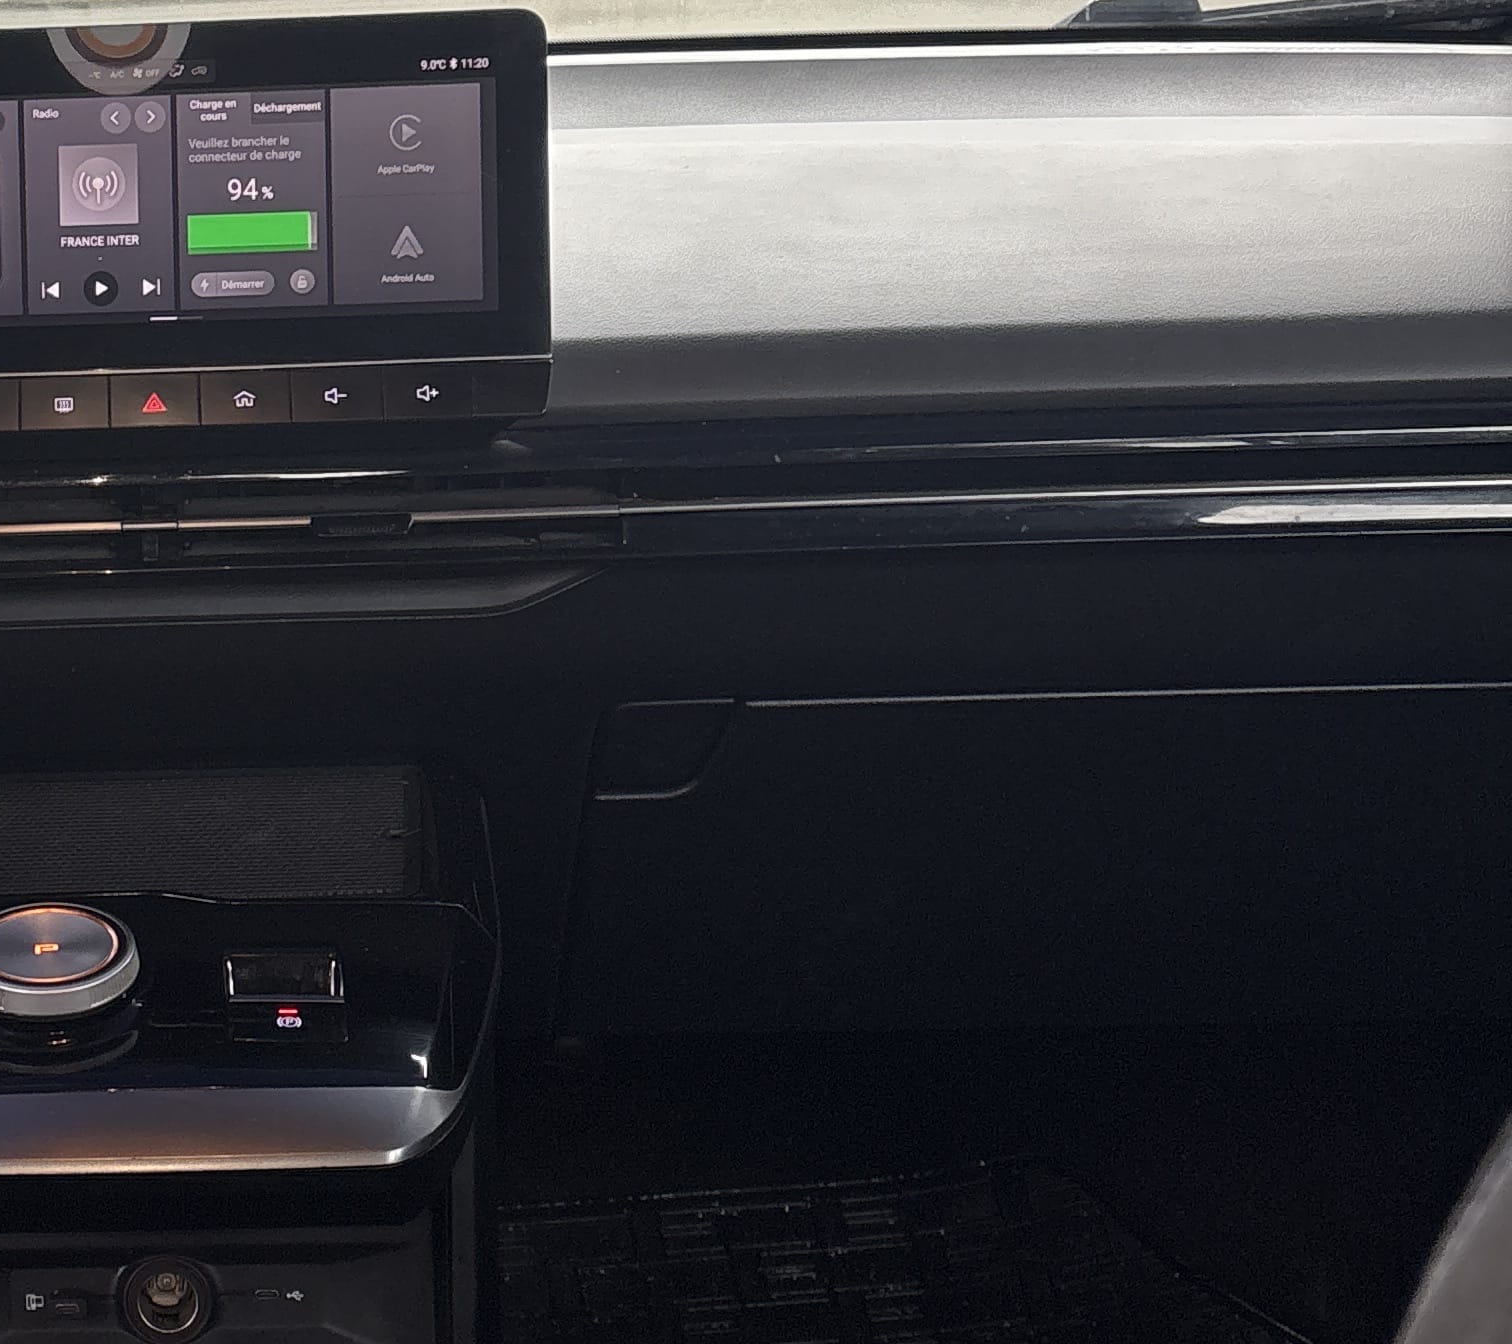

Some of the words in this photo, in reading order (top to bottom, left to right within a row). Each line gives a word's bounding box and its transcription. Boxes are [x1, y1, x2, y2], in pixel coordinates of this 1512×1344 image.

[461, 58, 489, 69] 11:20
[190, 100, 222, 111] Charge
[224, 100, 237, 108] en
[253, 102, 321, 114] Déchargement
[33, 109, 60, 119] Radio
[200, 112, 227, 121] cours
[188, 138, 229, 149] Veuillez
[231, 136, 277, 147] brancher
[279, 135, 289, 145] le
[188, 151, 247, 163] connecteur
[249, 150, 263, 160] de
[265, 149, 301, 161] charge
[377, 164, 401, 175] Apple
[403, 163, 434, 174] CarPlay
[61, 236, 105, 248] FRANCE
[107, 235, 139, 246] INTER
[381, 273, 413, 284] Android
[415, 274, 434, 283] Auto
[221, 280, 265, 290] Démarrer
[34, 943, 59, 955] P
